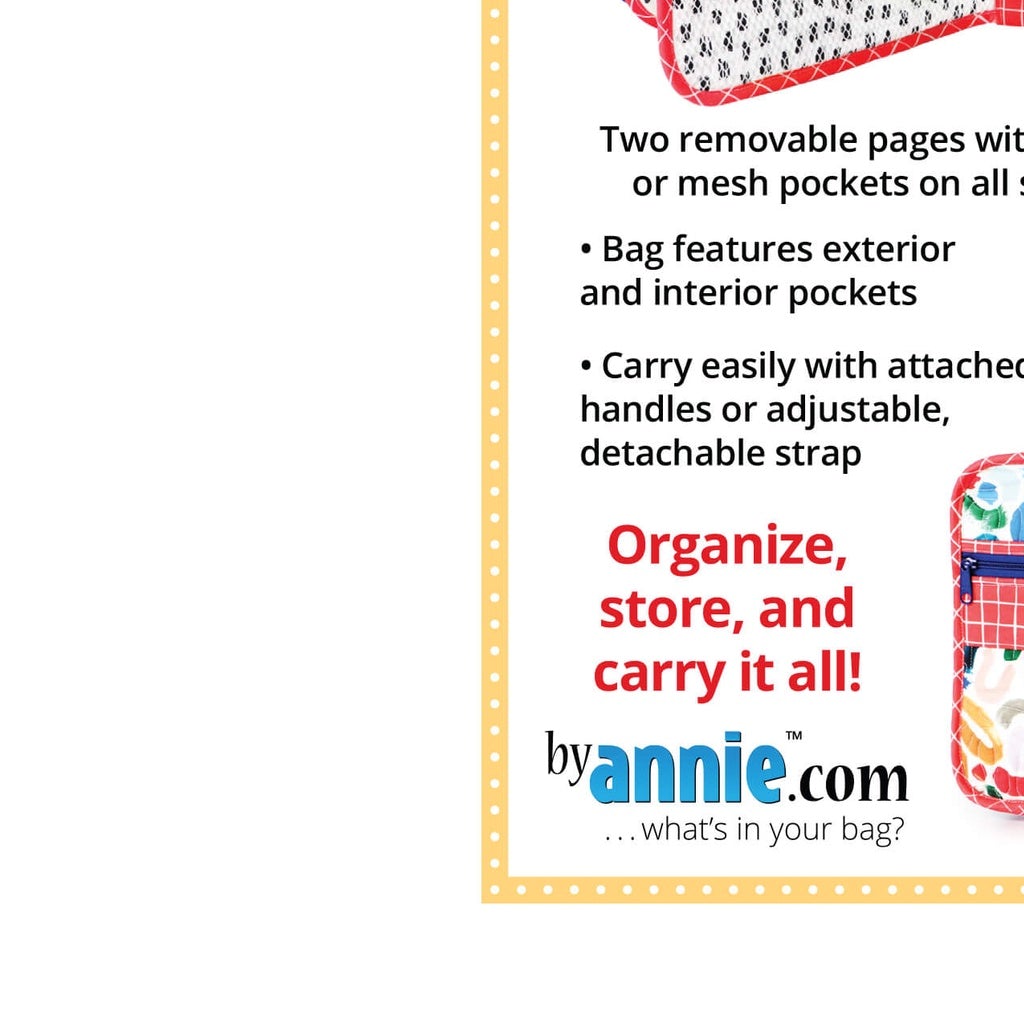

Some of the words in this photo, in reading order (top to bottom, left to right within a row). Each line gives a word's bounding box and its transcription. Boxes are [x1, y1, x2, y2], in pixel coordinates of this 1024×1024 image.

[599, 125, 669, 153] Two
[680, 124, 858, 153] removable
[869, 131, 966, 161] pages
[632, 175, 669, 197] or
[678, 167, 768, 197] mesh
[780, 167, 909, 205] pockets
[919, 175, 960, 197] on
[971, 167, 1008, 197] all
[603, 235, 665, 271] Bag
[672, 233, 813, 263] features
[823, 234, 956, 263] exterior
[580, 277, 642, 306] and
[654, 277, 779, 306] interior
[789, 277, 918, 315] pockets
[602, 351, 693, 388] Carry
[701, 350, 797, 388] easily
[804, 350, 877, 379] with
[581, 393, 712, 423] handles
[722, 401, 758, 423] or
[766, 393, 951, 431] adjustable,
[580, 437, 766, 467] detachable
[775, 441, 862, 475] strap
[608, 522, 848, 577] Organize,
[600, 591, 744, 635] store,
[759, 585, 853, 628] and
[594, 660, 727, 704] carry
[741, 649, 774, 692] it
[788, 649, 861, 692] all!
[738, 816, 760, 841] in
[769, 822, 833, 848] your
[842, 815, 905, 848] bag?
